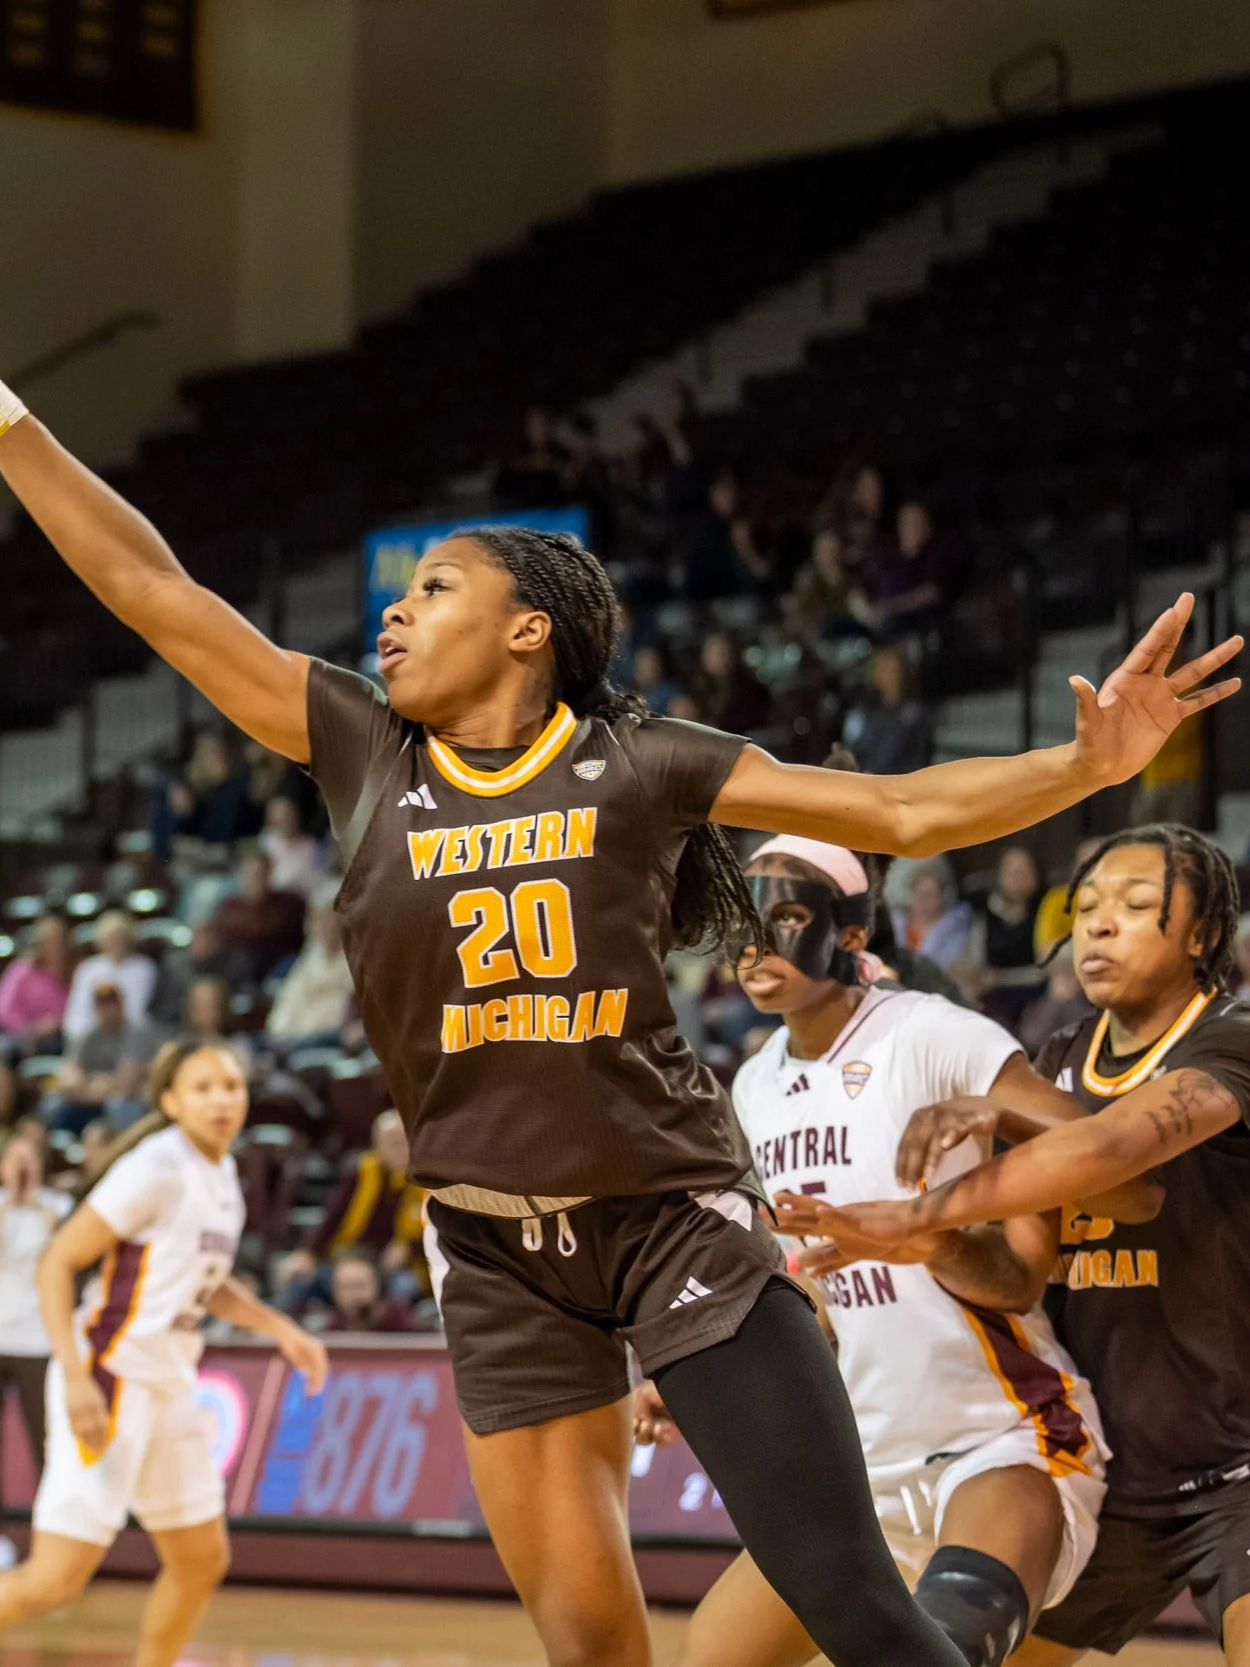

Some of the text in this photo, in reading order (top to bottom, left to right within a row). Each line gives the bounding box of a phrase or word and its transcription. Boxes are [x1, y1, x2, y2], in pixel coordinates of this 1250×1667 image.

[407, 807, 597, 880] WESTERN
[448, 878, 577, 988] 20
[441, 988, 628, 1053] MICHIGAN
[302, 1370, 437, 1517] 876
